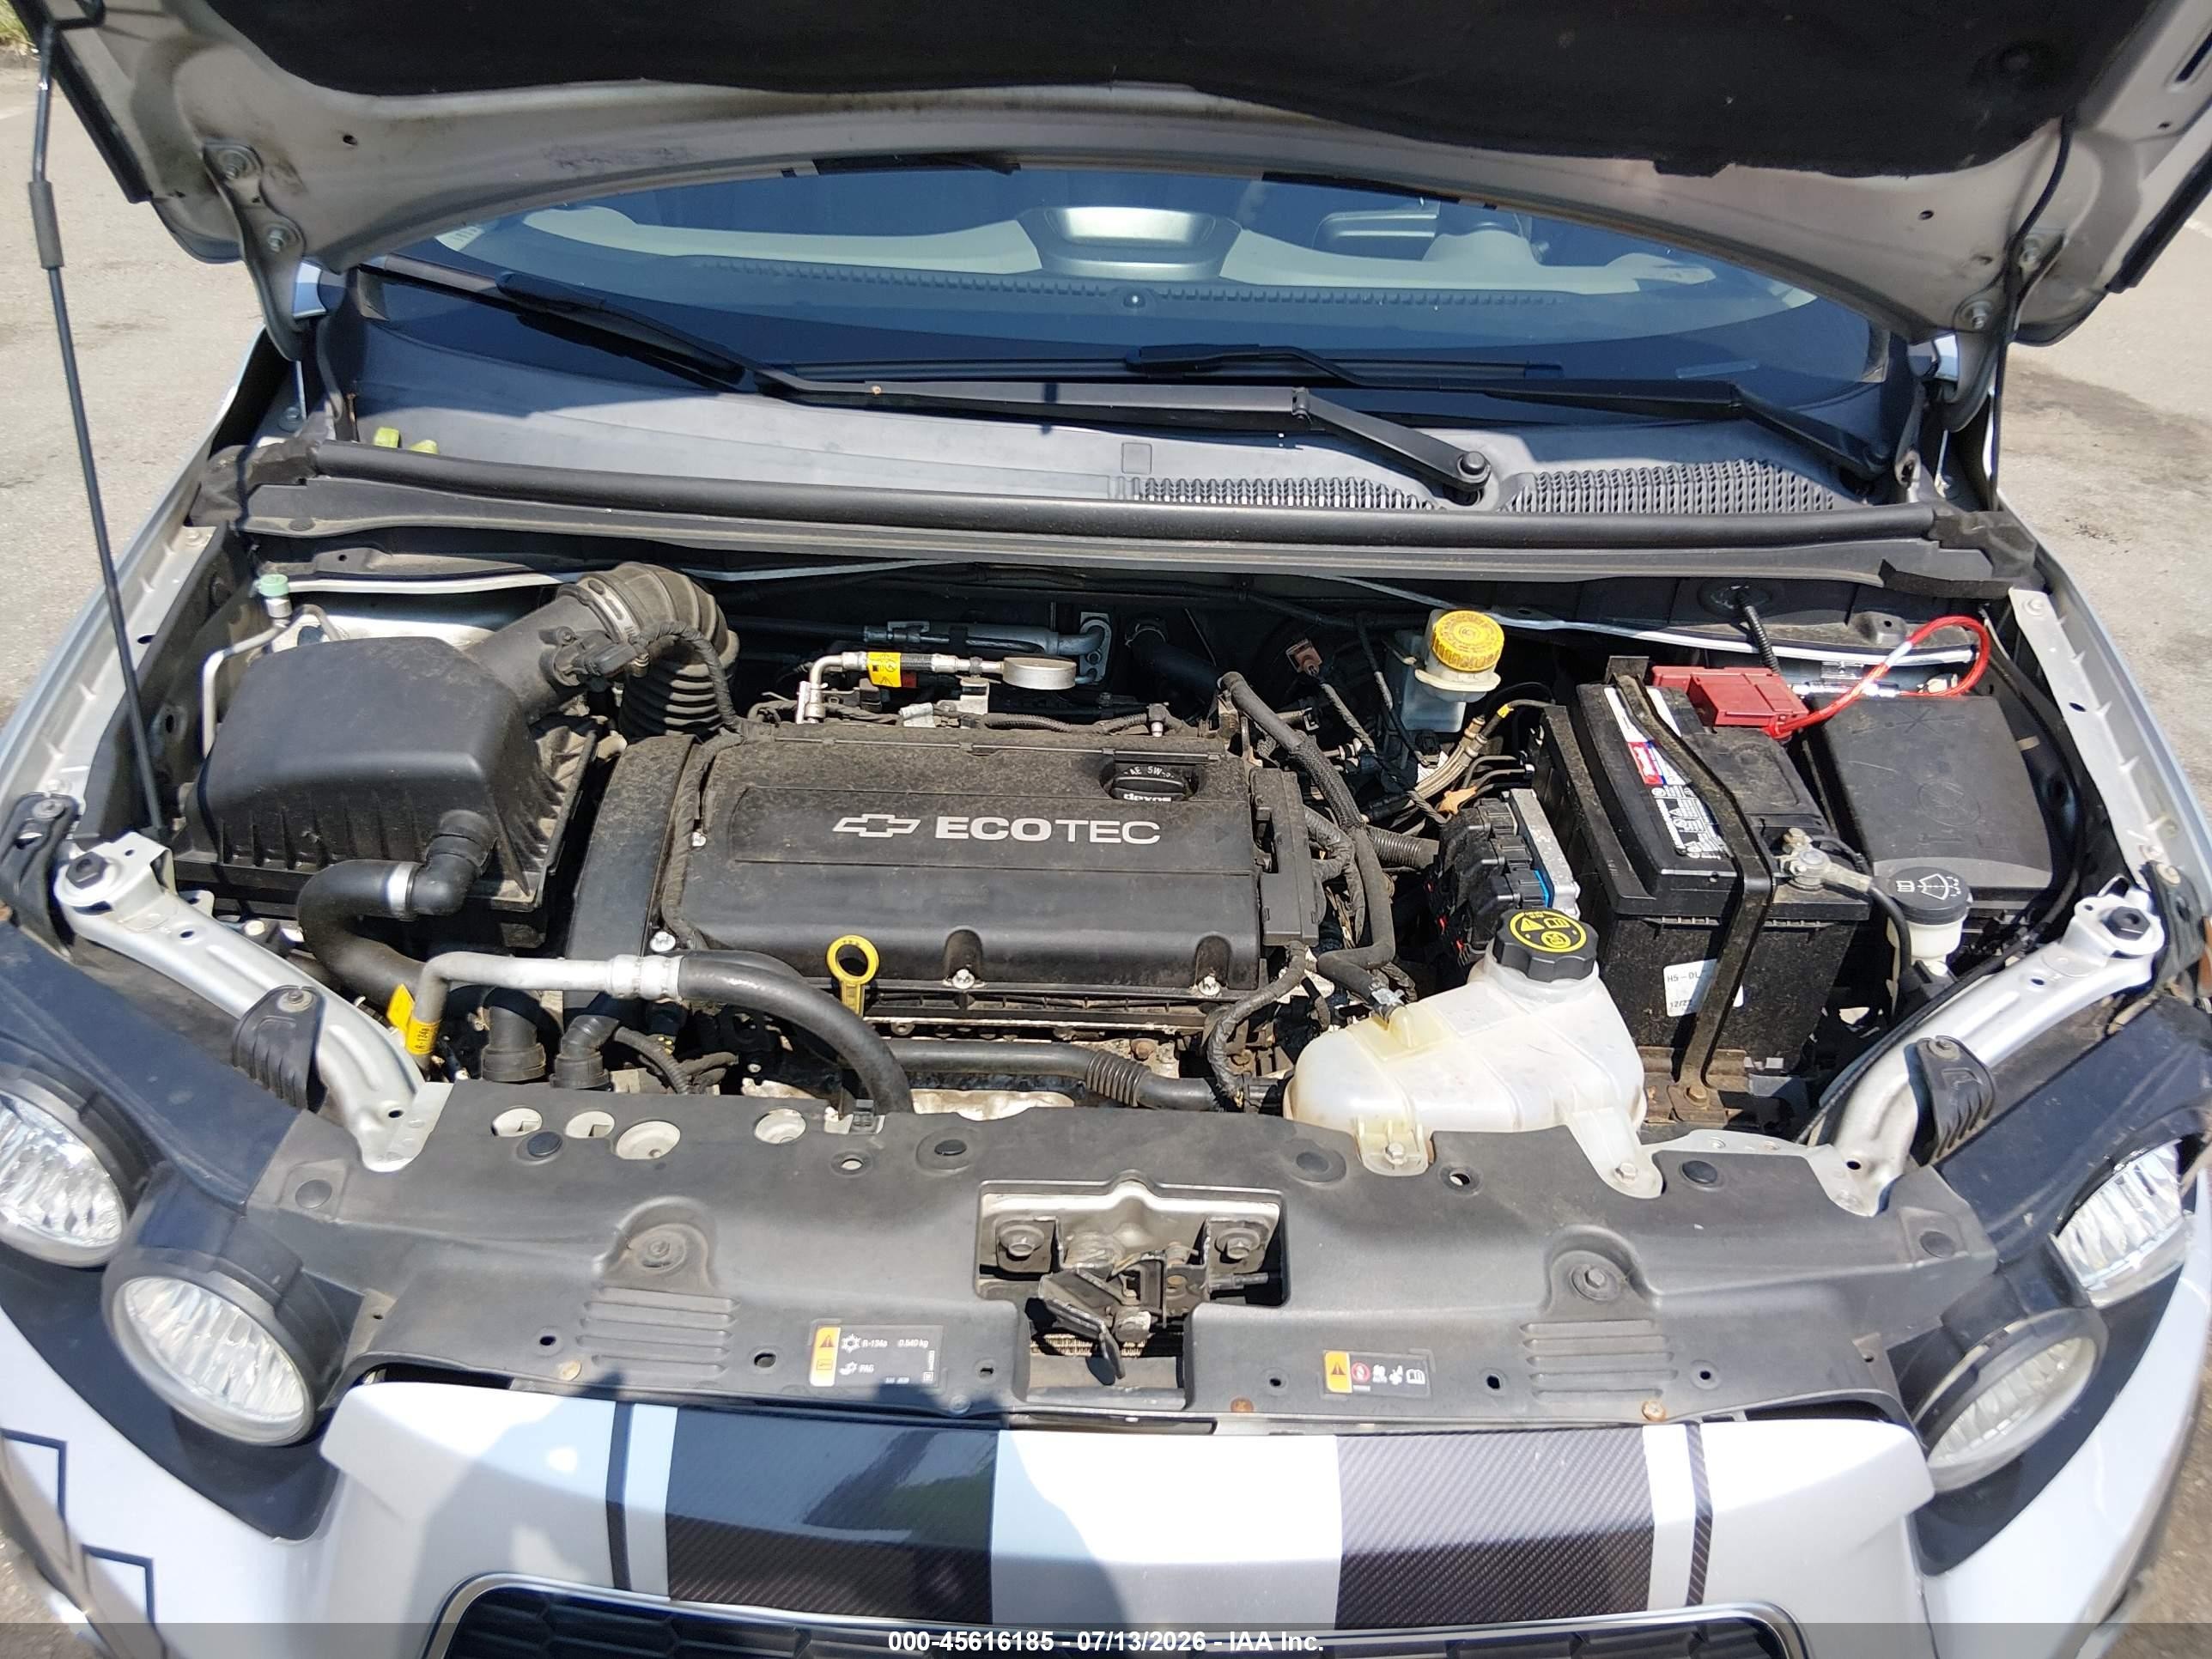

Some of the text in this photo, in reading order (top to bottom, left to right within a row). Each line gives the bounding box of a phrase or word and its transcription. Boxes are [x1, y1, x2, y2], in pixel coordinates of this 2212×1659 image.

[935, 816, 1161, 845] ECOTEC
[862, 1339, 888, 1348] R-134a
[919, 1339, 929, 1349] kg
[859, 1364, 874, 1373] PAG
